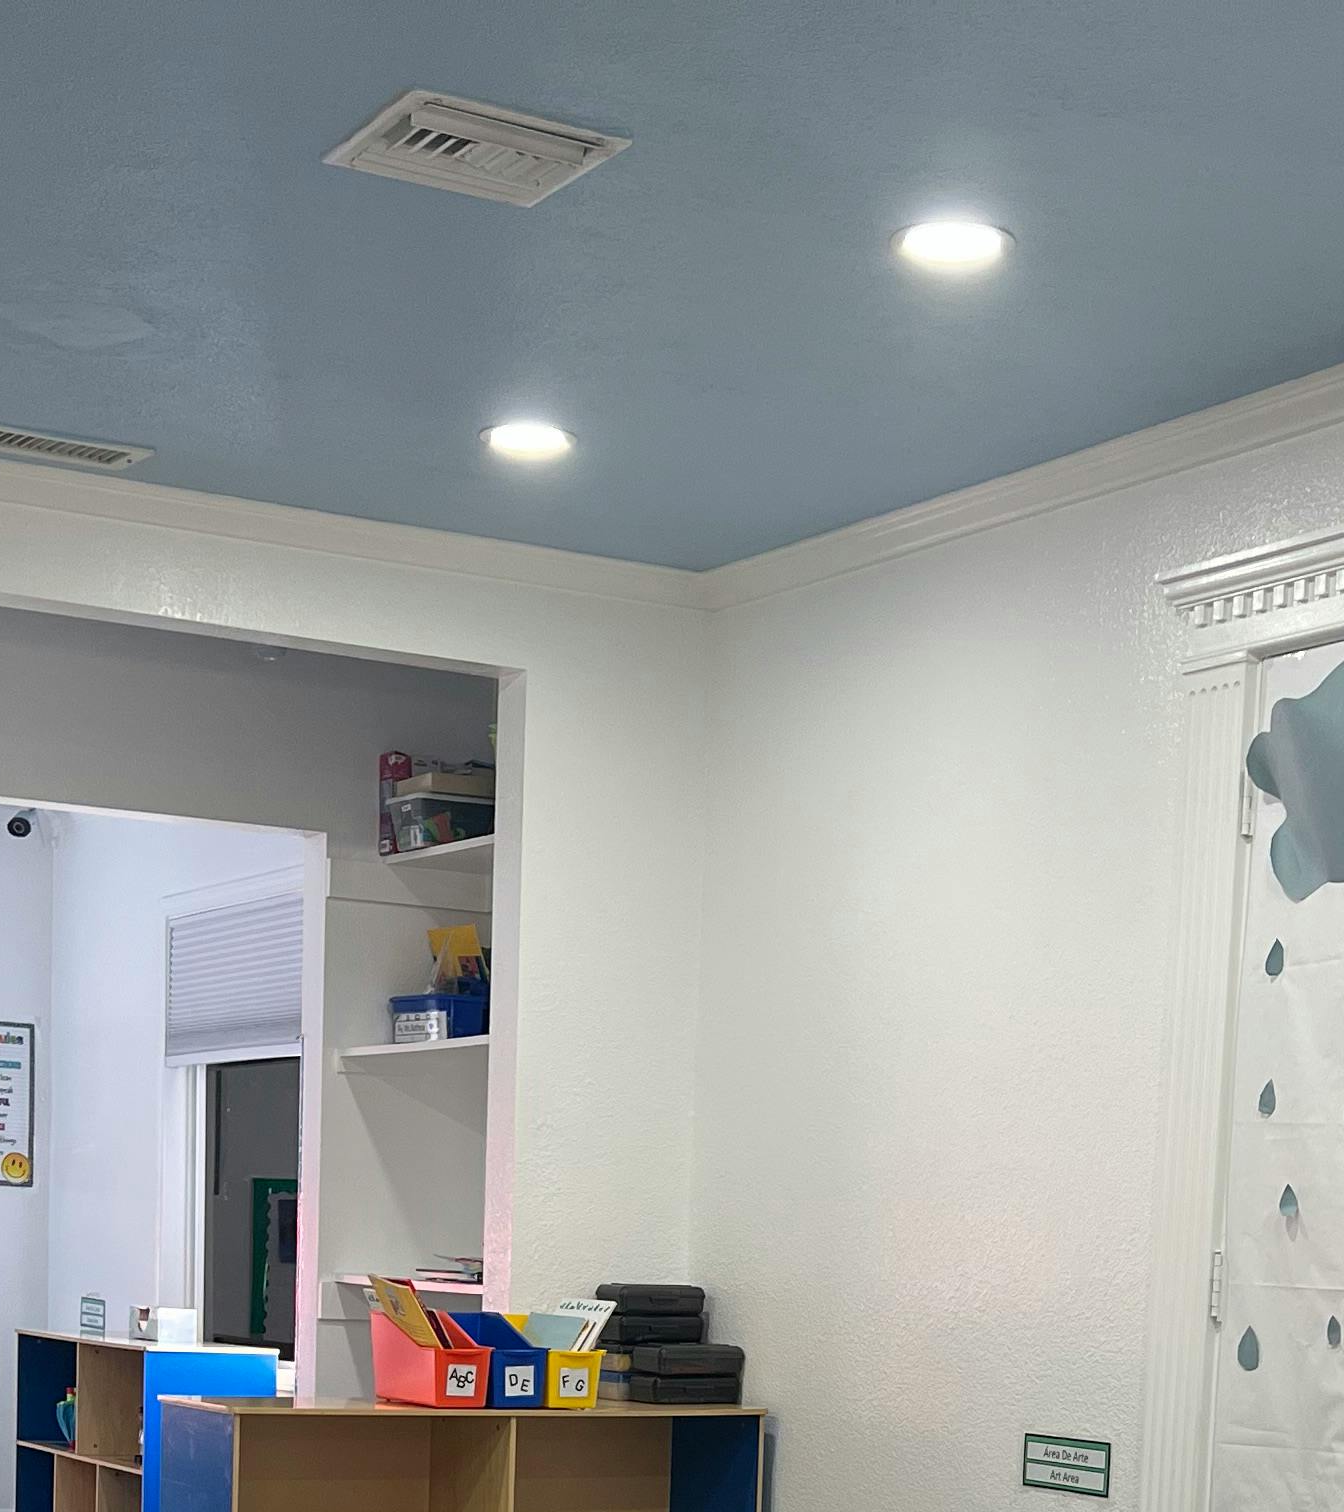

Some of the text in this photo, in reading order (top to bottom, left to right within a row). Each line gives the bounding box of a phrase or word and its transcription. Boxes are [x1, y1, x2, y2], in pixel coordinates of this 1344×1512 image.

[1043, 1446, 1089, 1463] Área De Arte
[1050, 1469, 1080, 1484] Art Area
